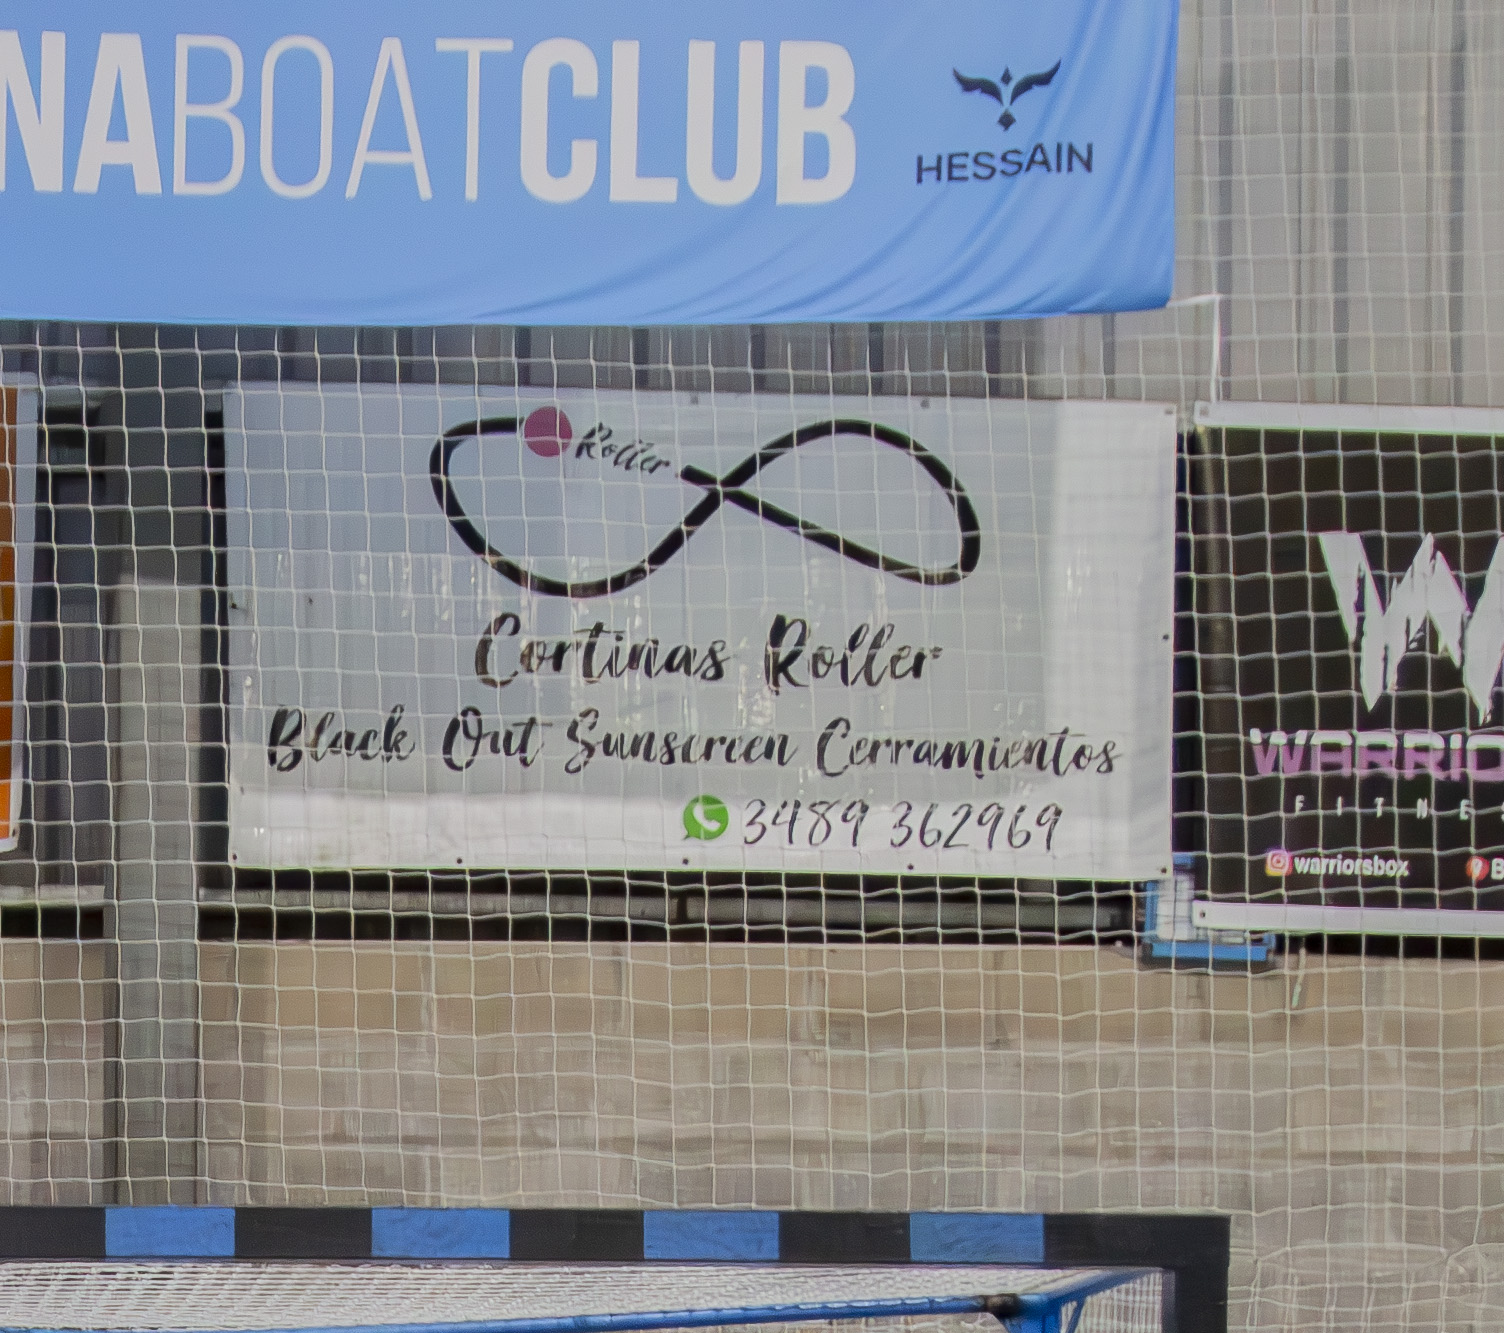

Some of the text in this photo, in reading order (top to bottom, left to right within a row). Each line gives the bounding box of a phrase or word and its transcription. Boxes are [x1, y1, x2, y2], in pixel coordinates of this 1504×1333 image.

[915, 141, 1094, 185] HESSAIN
[473, 611, 943, 696] Cortinas Roller
[267, 703, 1124, 781] Black Out Sunscreen Cerramientos
[743, 797, 1064, 853] 3489 362969
[1294, 854, 1410, 878] warriorsbox
